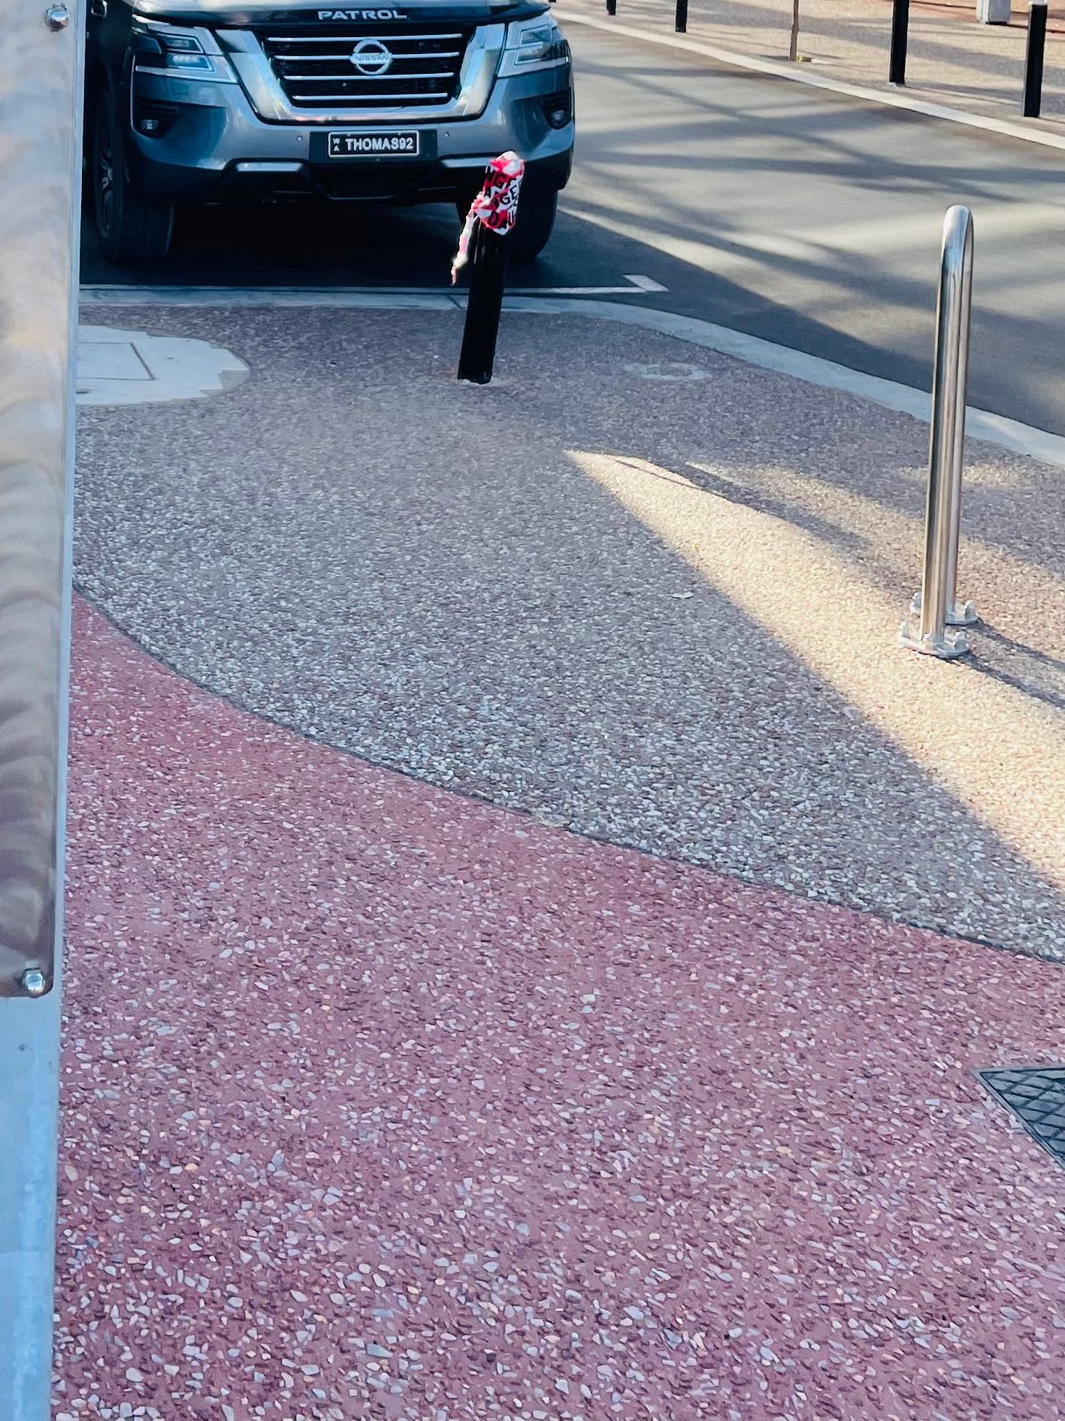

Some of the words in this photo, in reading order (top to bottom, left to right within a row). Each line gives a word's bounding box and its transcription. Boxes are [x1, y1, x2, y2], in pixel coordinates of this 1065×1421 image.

[317, 10, 408, 20] PATROL
[354, 53, 390, 62] NISSAN
[345, 137, 414, 151] THOMAS92
